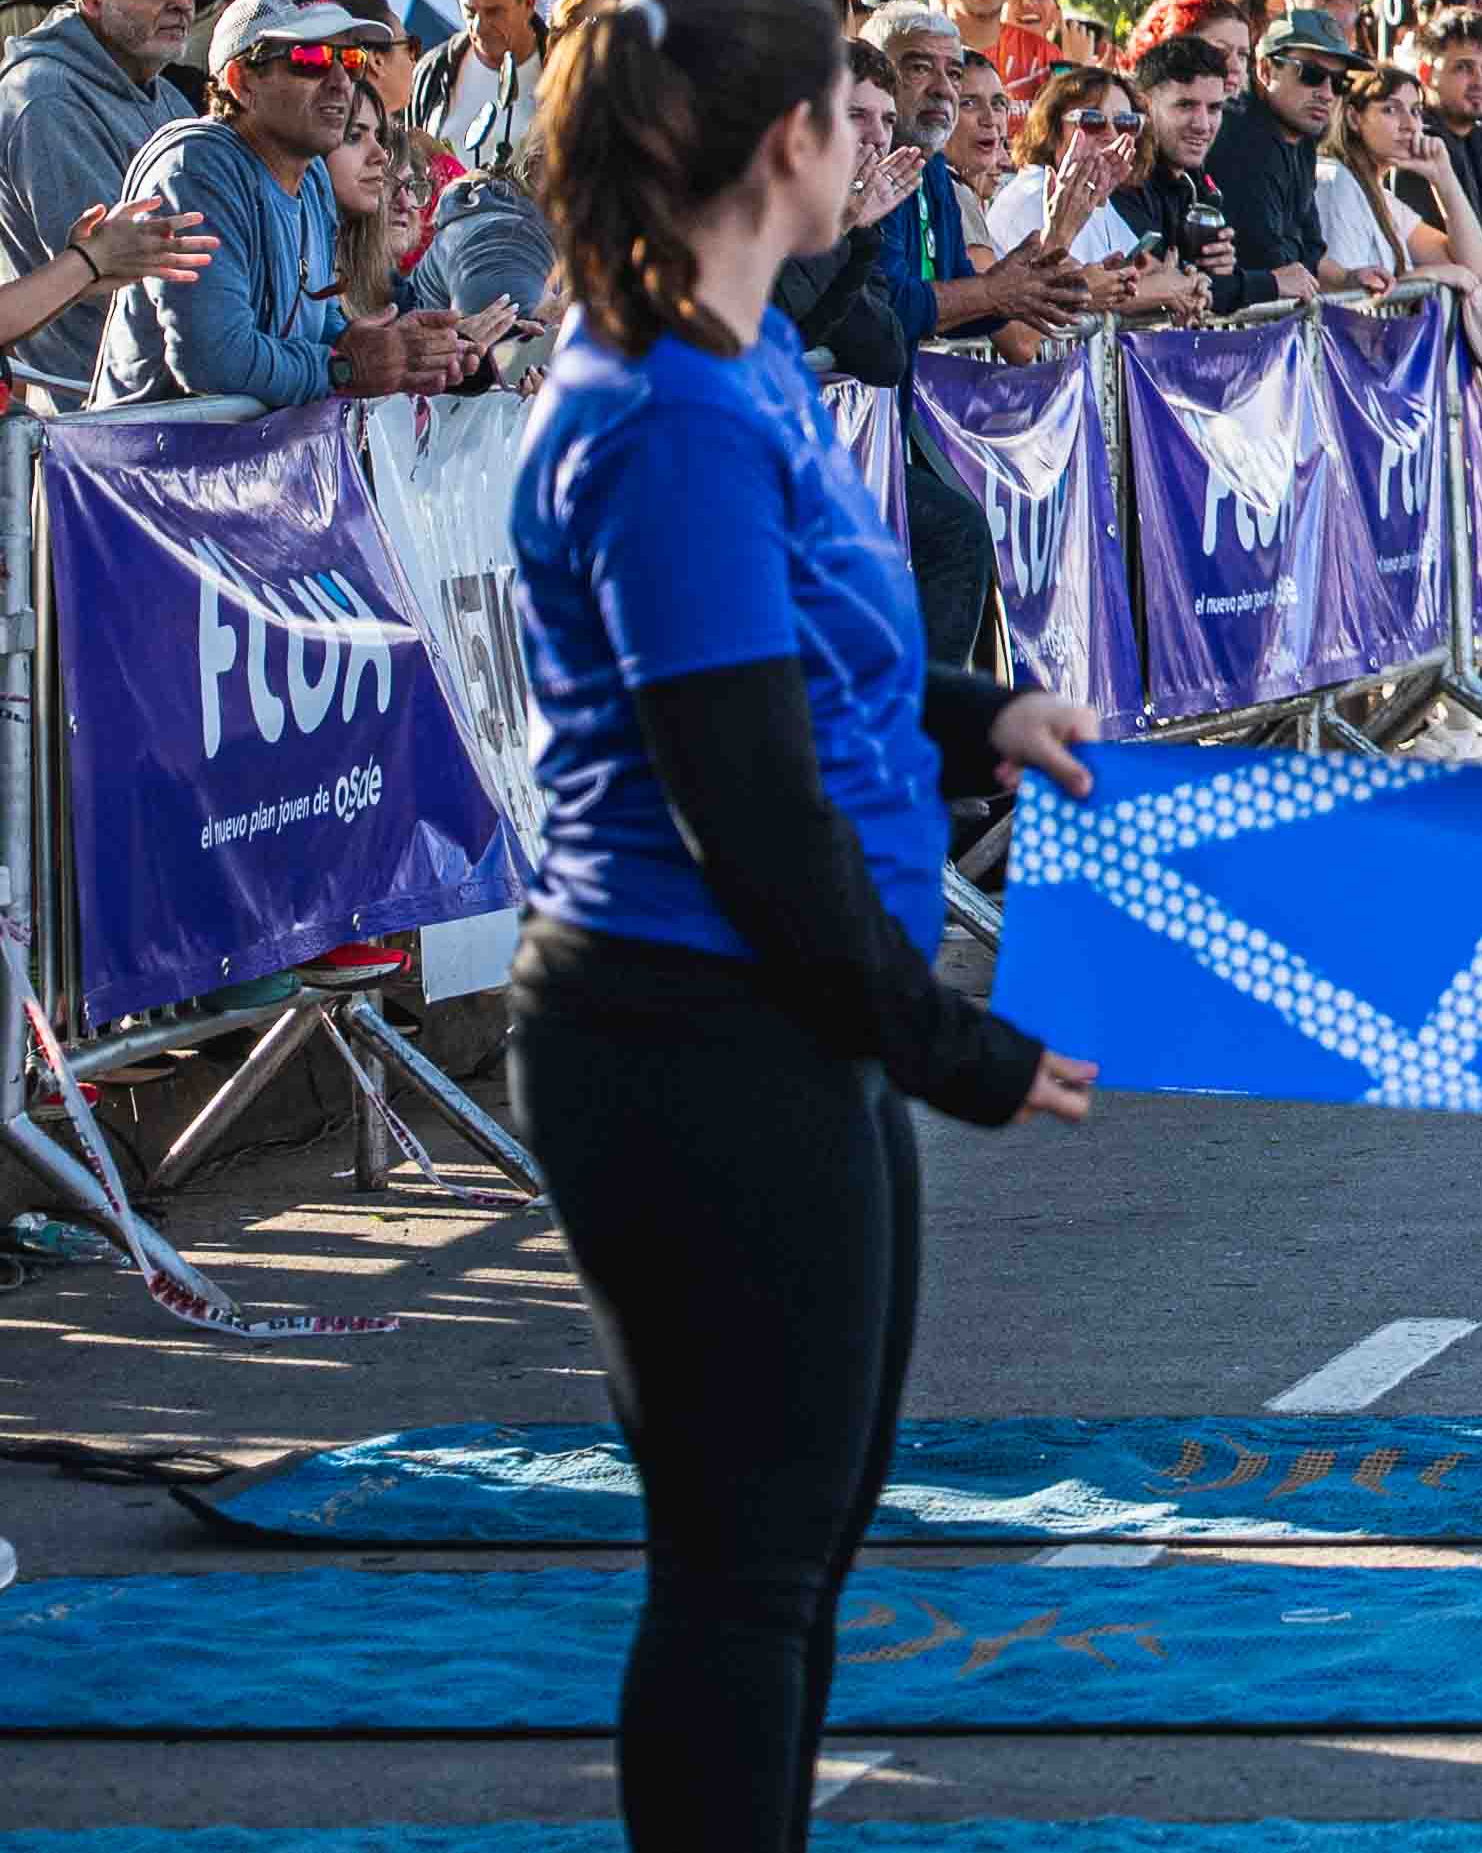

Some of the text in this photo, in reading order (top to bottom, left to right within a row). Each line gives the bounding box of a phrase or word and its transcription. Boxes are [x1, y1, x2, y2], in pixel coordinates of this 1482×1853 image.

[201, 755, 383, 850] el nuevo plan joven de osde
